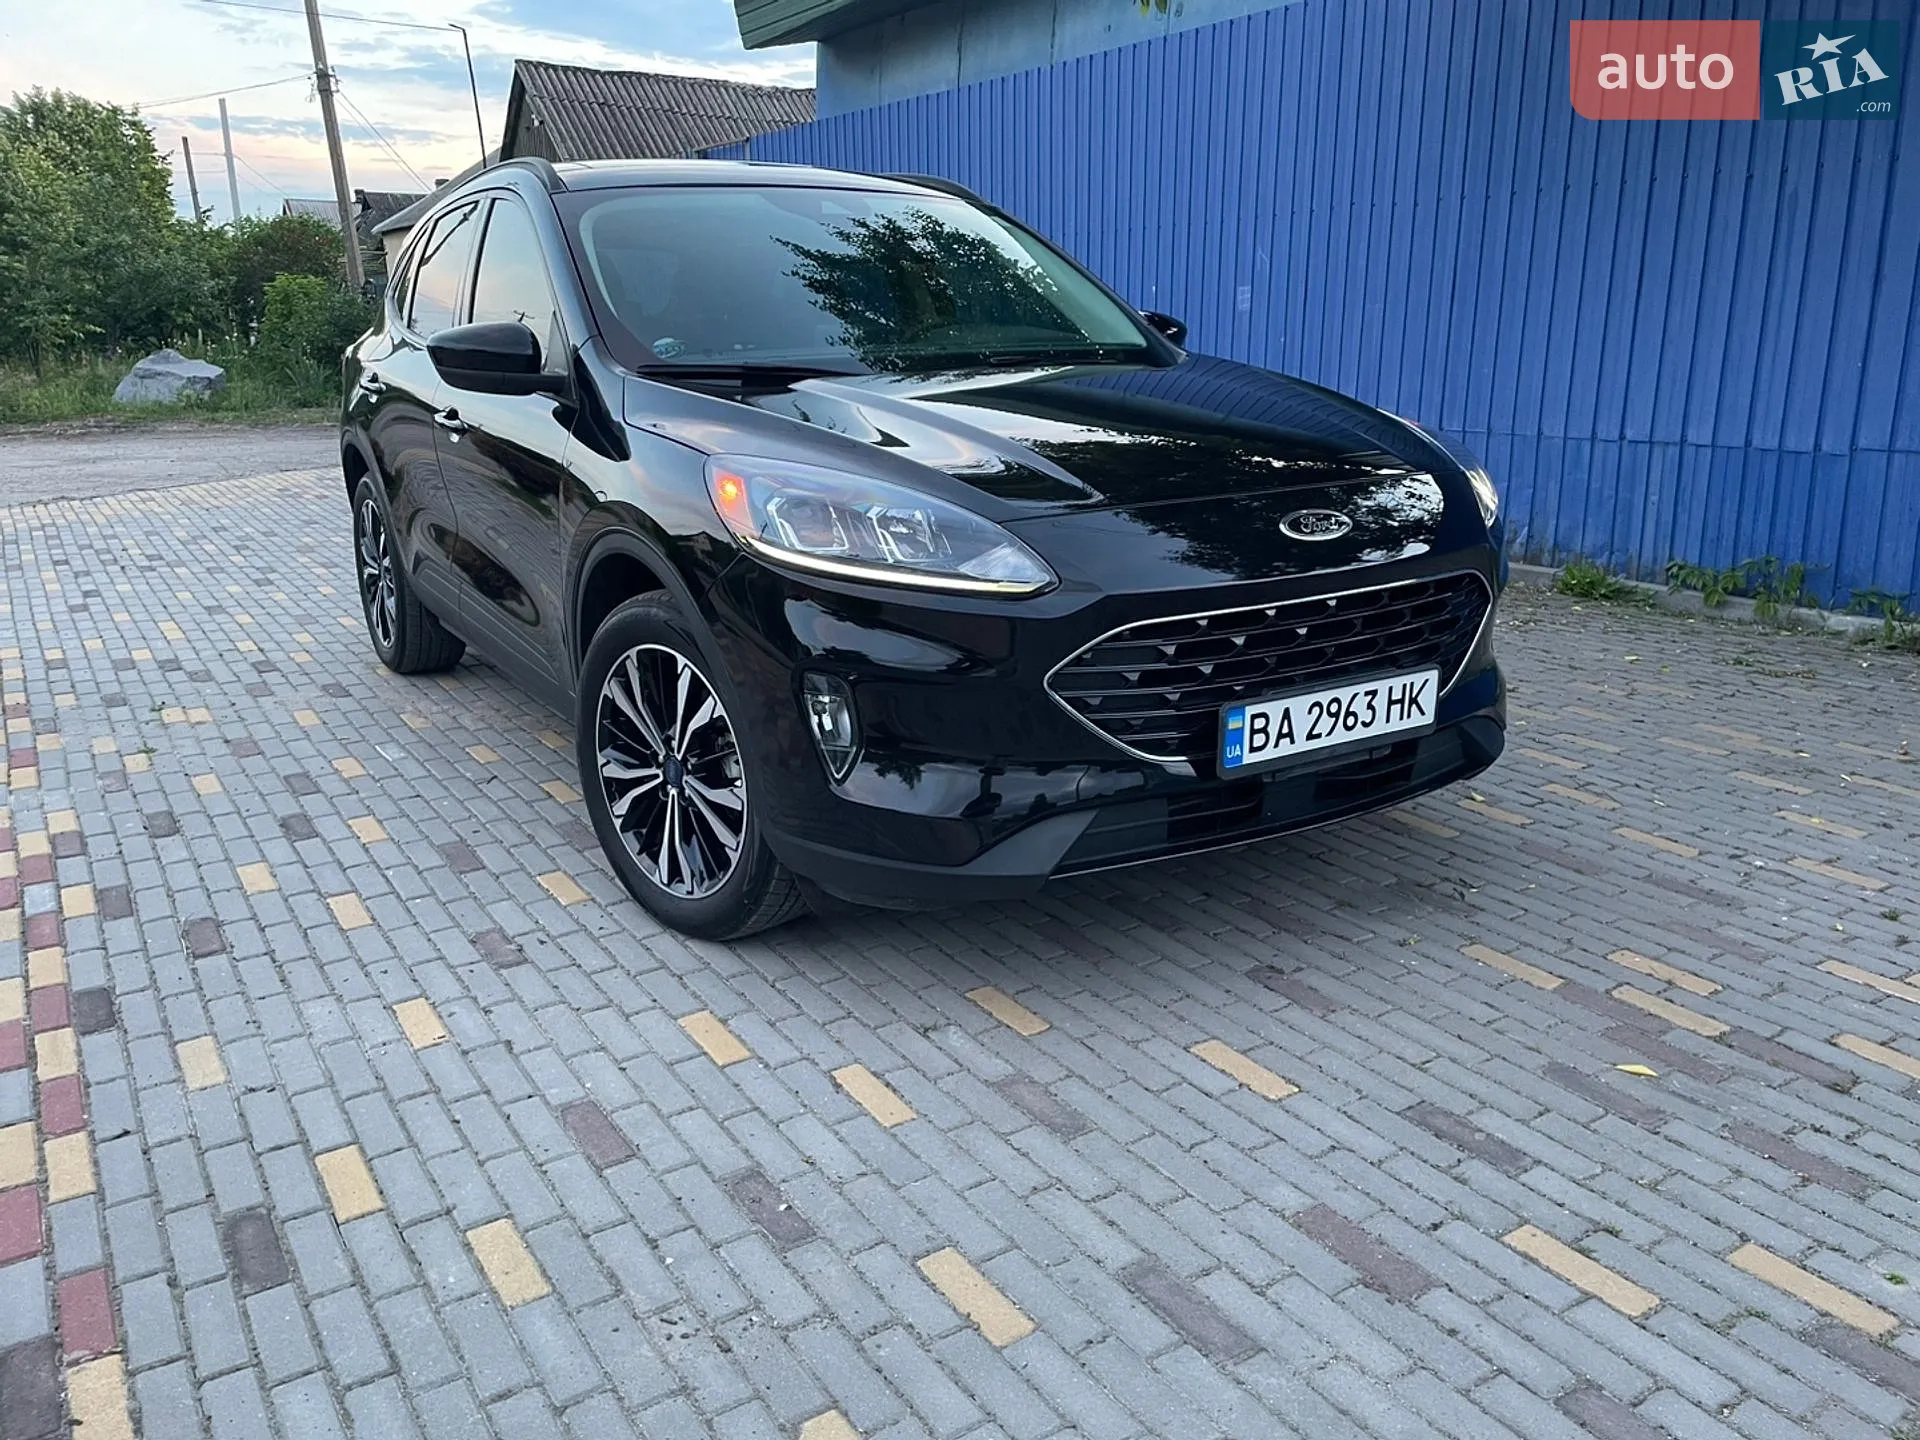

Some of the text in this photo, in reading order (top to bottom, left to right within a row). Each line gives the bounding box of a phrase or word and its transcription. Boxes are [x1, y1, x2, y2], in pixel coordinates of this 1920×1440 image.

[1299, 516, 1340, 533] Ford
[1249, 678, 1429, 754] BA 2963 HK
[1227, 744, 1242, 758] UA
